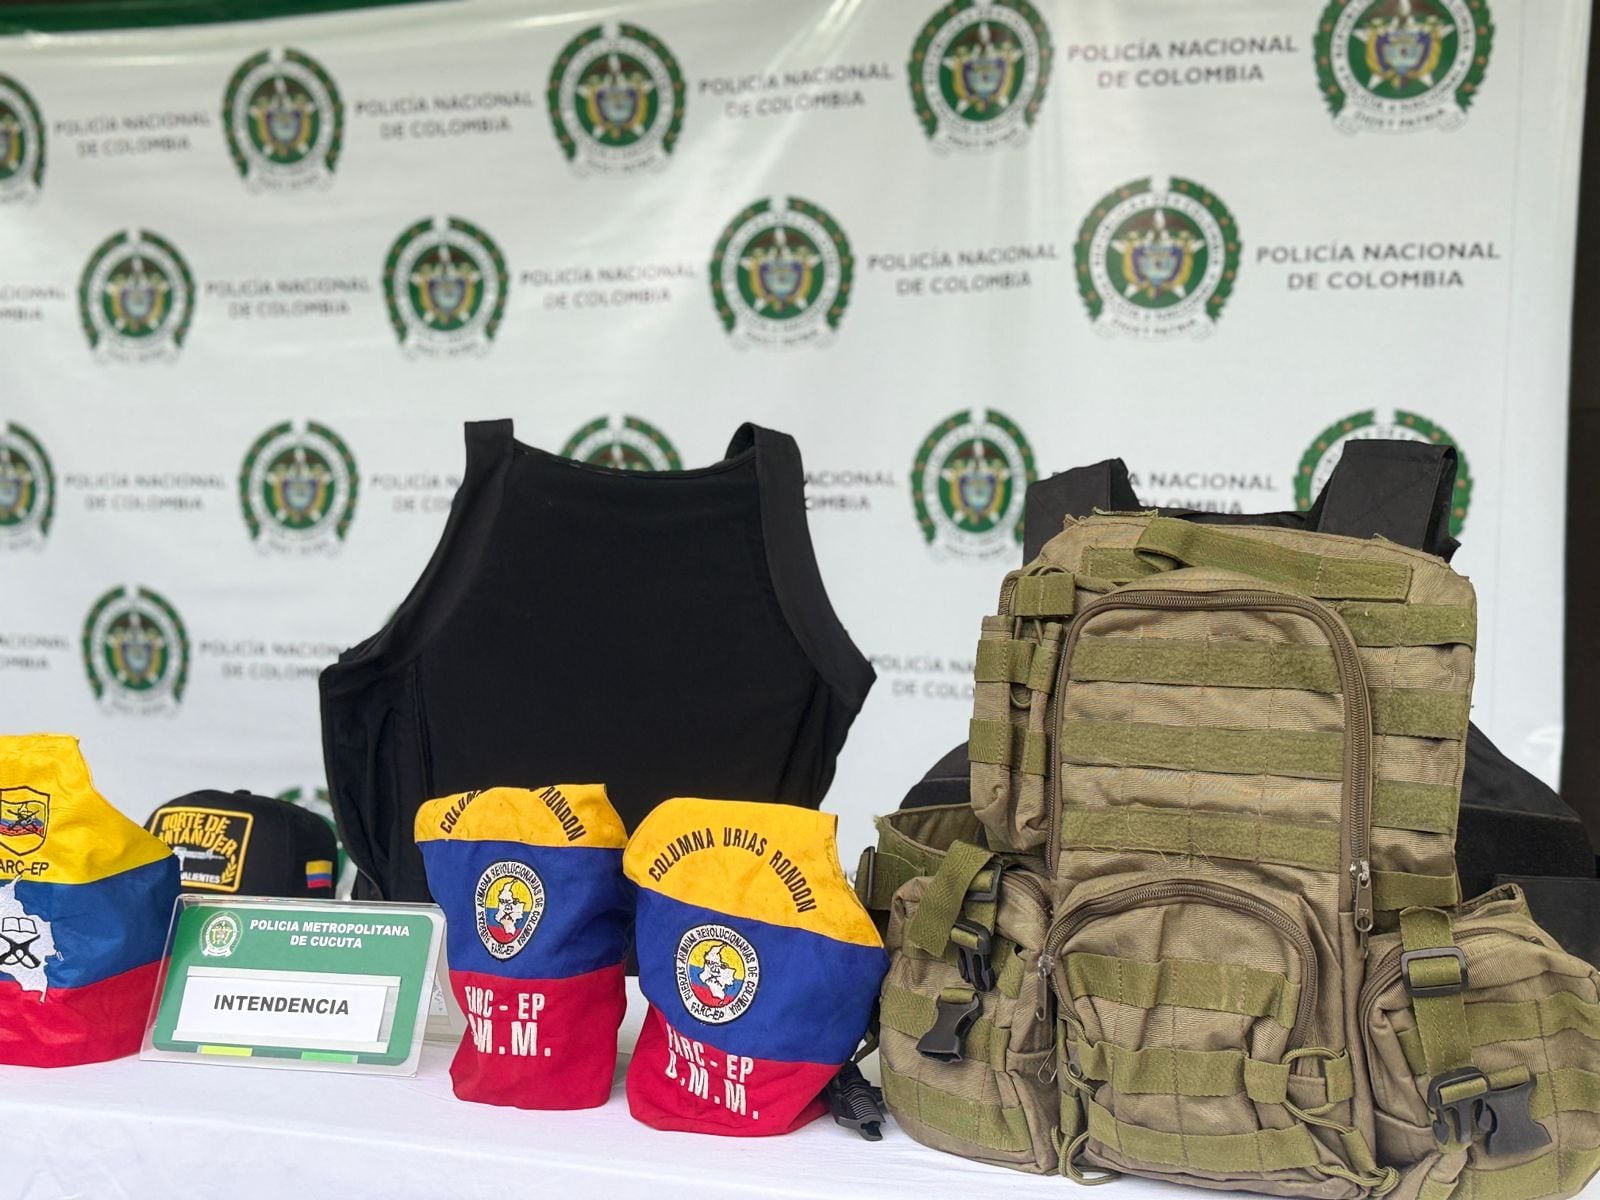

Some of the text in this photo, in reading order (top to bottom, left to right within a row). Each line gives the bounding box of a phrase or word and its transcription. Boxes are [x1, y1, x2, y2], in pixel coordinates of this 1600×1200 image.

[1067, 35, 1299, 62] POLICÍA NACIONAL
[784, 63, 893, 84] NACIONAL
[1098, 64, 1264, 88] DE COLOMBIA
[433, 91, 534, 112] NACIONAL
[725, 89, 865, 118] DE COLOMBIA
[409, 115, 512, 138] COLOMBIA
[957, 243, 1060, 267] NACIONAL
[1256, 239, 1501, 264] POLICÍA NACIONAL
[598, 263, 697, 282] NACIONAL
[896, 270, 1032, 296] DE COLOMBIA
[1287, 270, 1464, 290] DE COLOMBIA
[572, 288, 673, 309] COLOMBIA
[804, 470, 898, 489] ACIONAL
[1150, 472, 1277, 491] NACIONAL
[805, 495, 872, 512] OMBIA
[162, 812, 231, 834] NORTE DE
[440, 786, 587, 842] COLUM RONDON
[0, 859, 50, 877] ARC-EP
[649, 826, 817, 913] COLUMNA URIAS RONDON
[250, 919, 410, 937] POLICIA METROPOLITANA
[290, 935, 363, 949] DE CUCUTA
[695, 926, 756, 964] REVOLUCIONARIAS
[746, 966, 759, 978] DE
[214, 994, 350, 1015] INTENDENCIA
